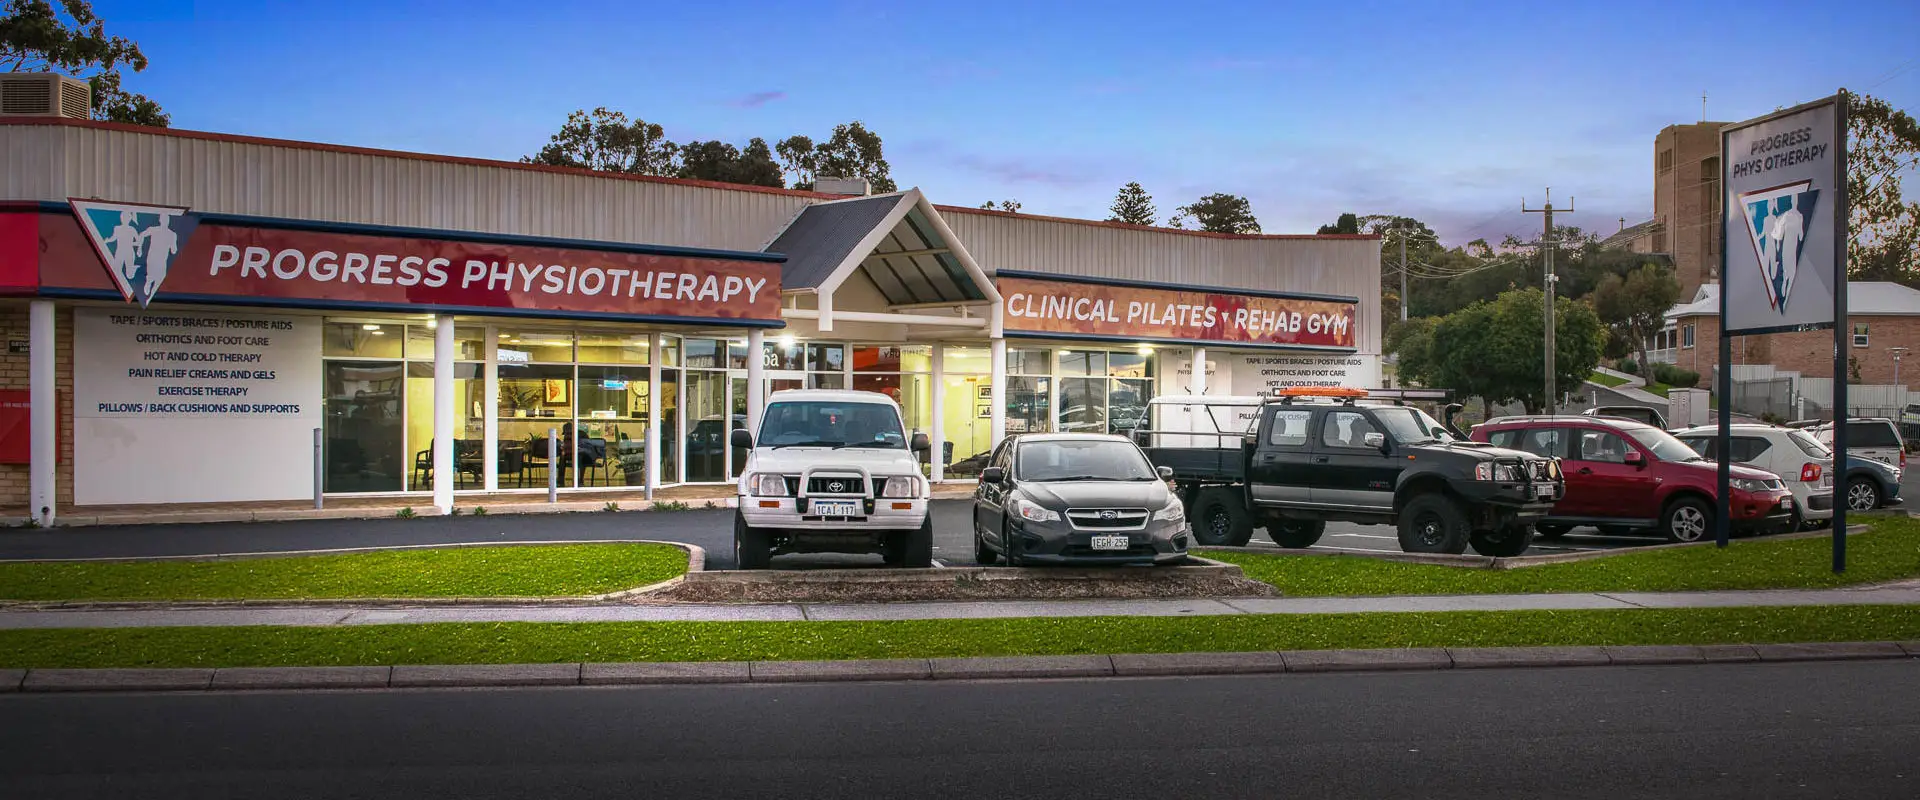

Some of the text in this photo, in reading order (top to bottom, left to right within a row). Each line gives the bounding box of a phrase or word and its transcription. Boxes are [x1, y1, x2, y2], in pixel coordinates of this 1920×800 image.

[1750, 127, 1812, 155] PROGRESS
[1733, 143, 1828, 178] PHYSOTHERAPY
[210, 244, 767, 304] PROGRESS PHYSIOTHERAPY
[1007, 293, 1349, 336] CLINICAL PILATES REHAB GYM
[110, 315, 136, 325] TAPE
[142, 316, 181, 327] SPORTS
[182, 317, 219, 328] BRACES
[226, 319, 269, 329] POSTURE
[271, 320, 293, 330] AIDS
[136, 333, 269, 346] ORTHOTICS AND FOOT CARE
[144, 352, 262, 363] HOT AND COLD THERAPY
[128, 368, 276, 380] PAIN RELIEF CREAMS AND GELS
[158, 386, 249, 397] EXERCISE THERAPY
[98, 403, 143, 413] PILLOWS
[150, 403, 176, 413] BACK
[178, 403, 228, 413] CUSHIONS
[230, 404, 251, 413] AND
[252, 404, 300, 414] SUPPORTS
